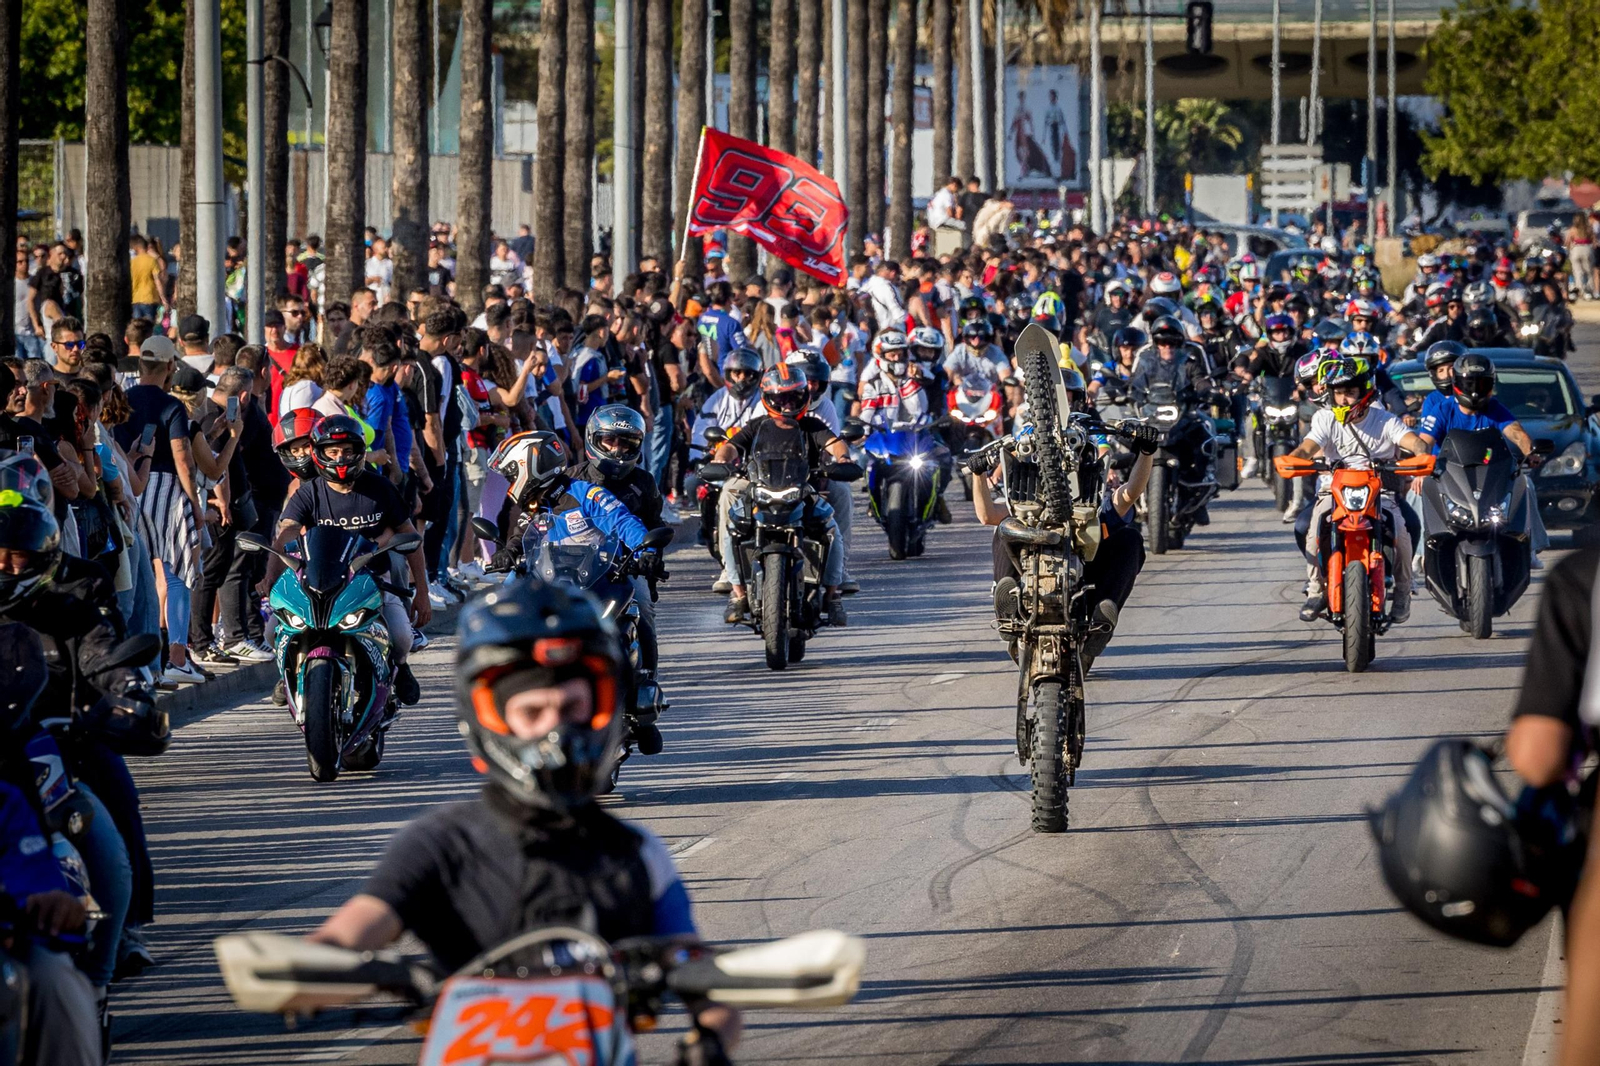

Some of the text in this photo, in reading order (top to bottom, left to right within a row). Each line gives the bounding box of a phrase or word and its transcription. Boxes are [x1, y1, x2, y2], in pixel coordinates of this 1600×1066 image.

[694, 149, 848, 255] 93
[351, 512, 382, 525] CLUB
[442, 996, 613, 1064] 242
